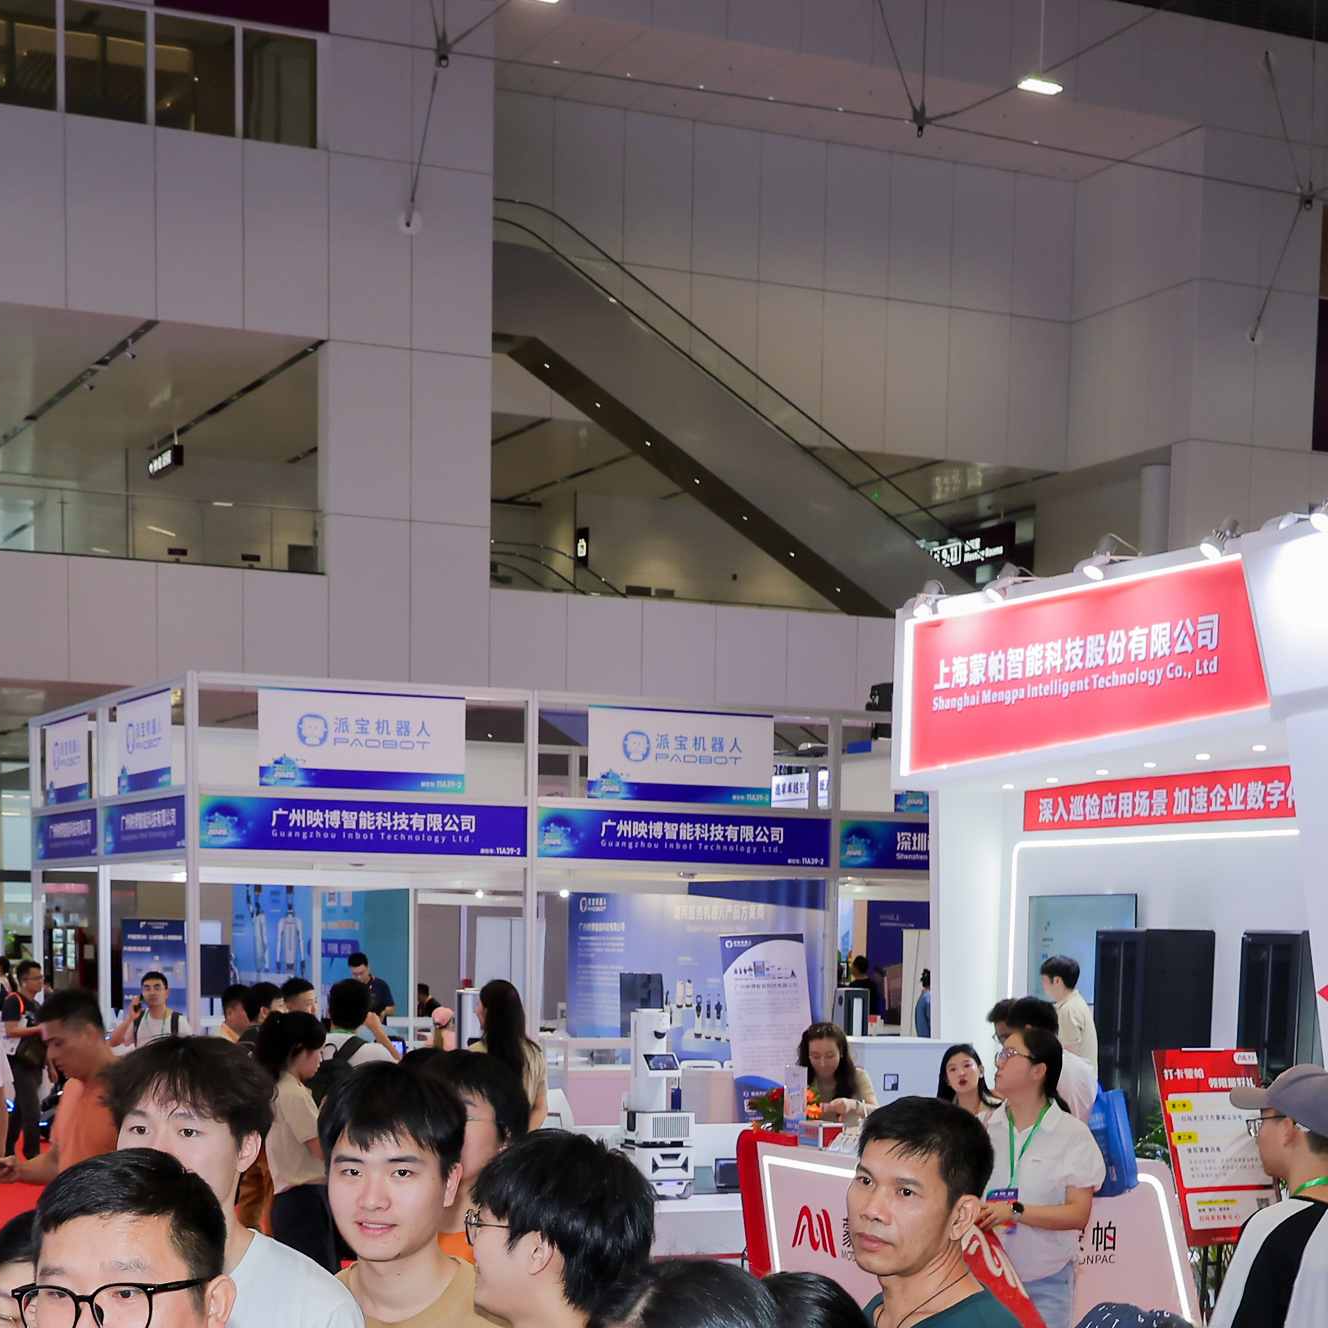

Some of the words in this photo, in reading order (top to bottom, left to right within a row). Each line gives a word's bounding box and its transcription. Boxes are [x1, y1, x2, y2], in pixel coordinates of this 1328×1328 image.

[932, 612, 1220, 691] 上海蒙帕智能科技股份有限公司
[931, 690, 980, 713] Shanghai
[981, 686, 1025, 706] Mengpa
[1026, 677, 1090, 699] Intelligent
[1091, 666, 1163, 689] Technology
[1166, 661, 1193, 681] Co.,
[1195, 655, 1220, 676] Ltd
[333, 716, 432, 738] 派宝机器人
[656, 731, 743, 754] 派宝机器人
[1038, 788, 1168, 824] 深入巡检应用场景
[271, 807, 477, 834] 广州映博智能科技有限公司
[600, 819, 785, 845] 广州映博智能科技有限公司
[271, 829, 337, 840] Guangzhou
[380, 832, 447, 844] Technology
[600, 839, 660, 851] Guangzhou
[698, 844, 756, 855] Technology
[896, 831, 930, 851] 深圳
[1078, 1253, 1117, 1266] NPAC
